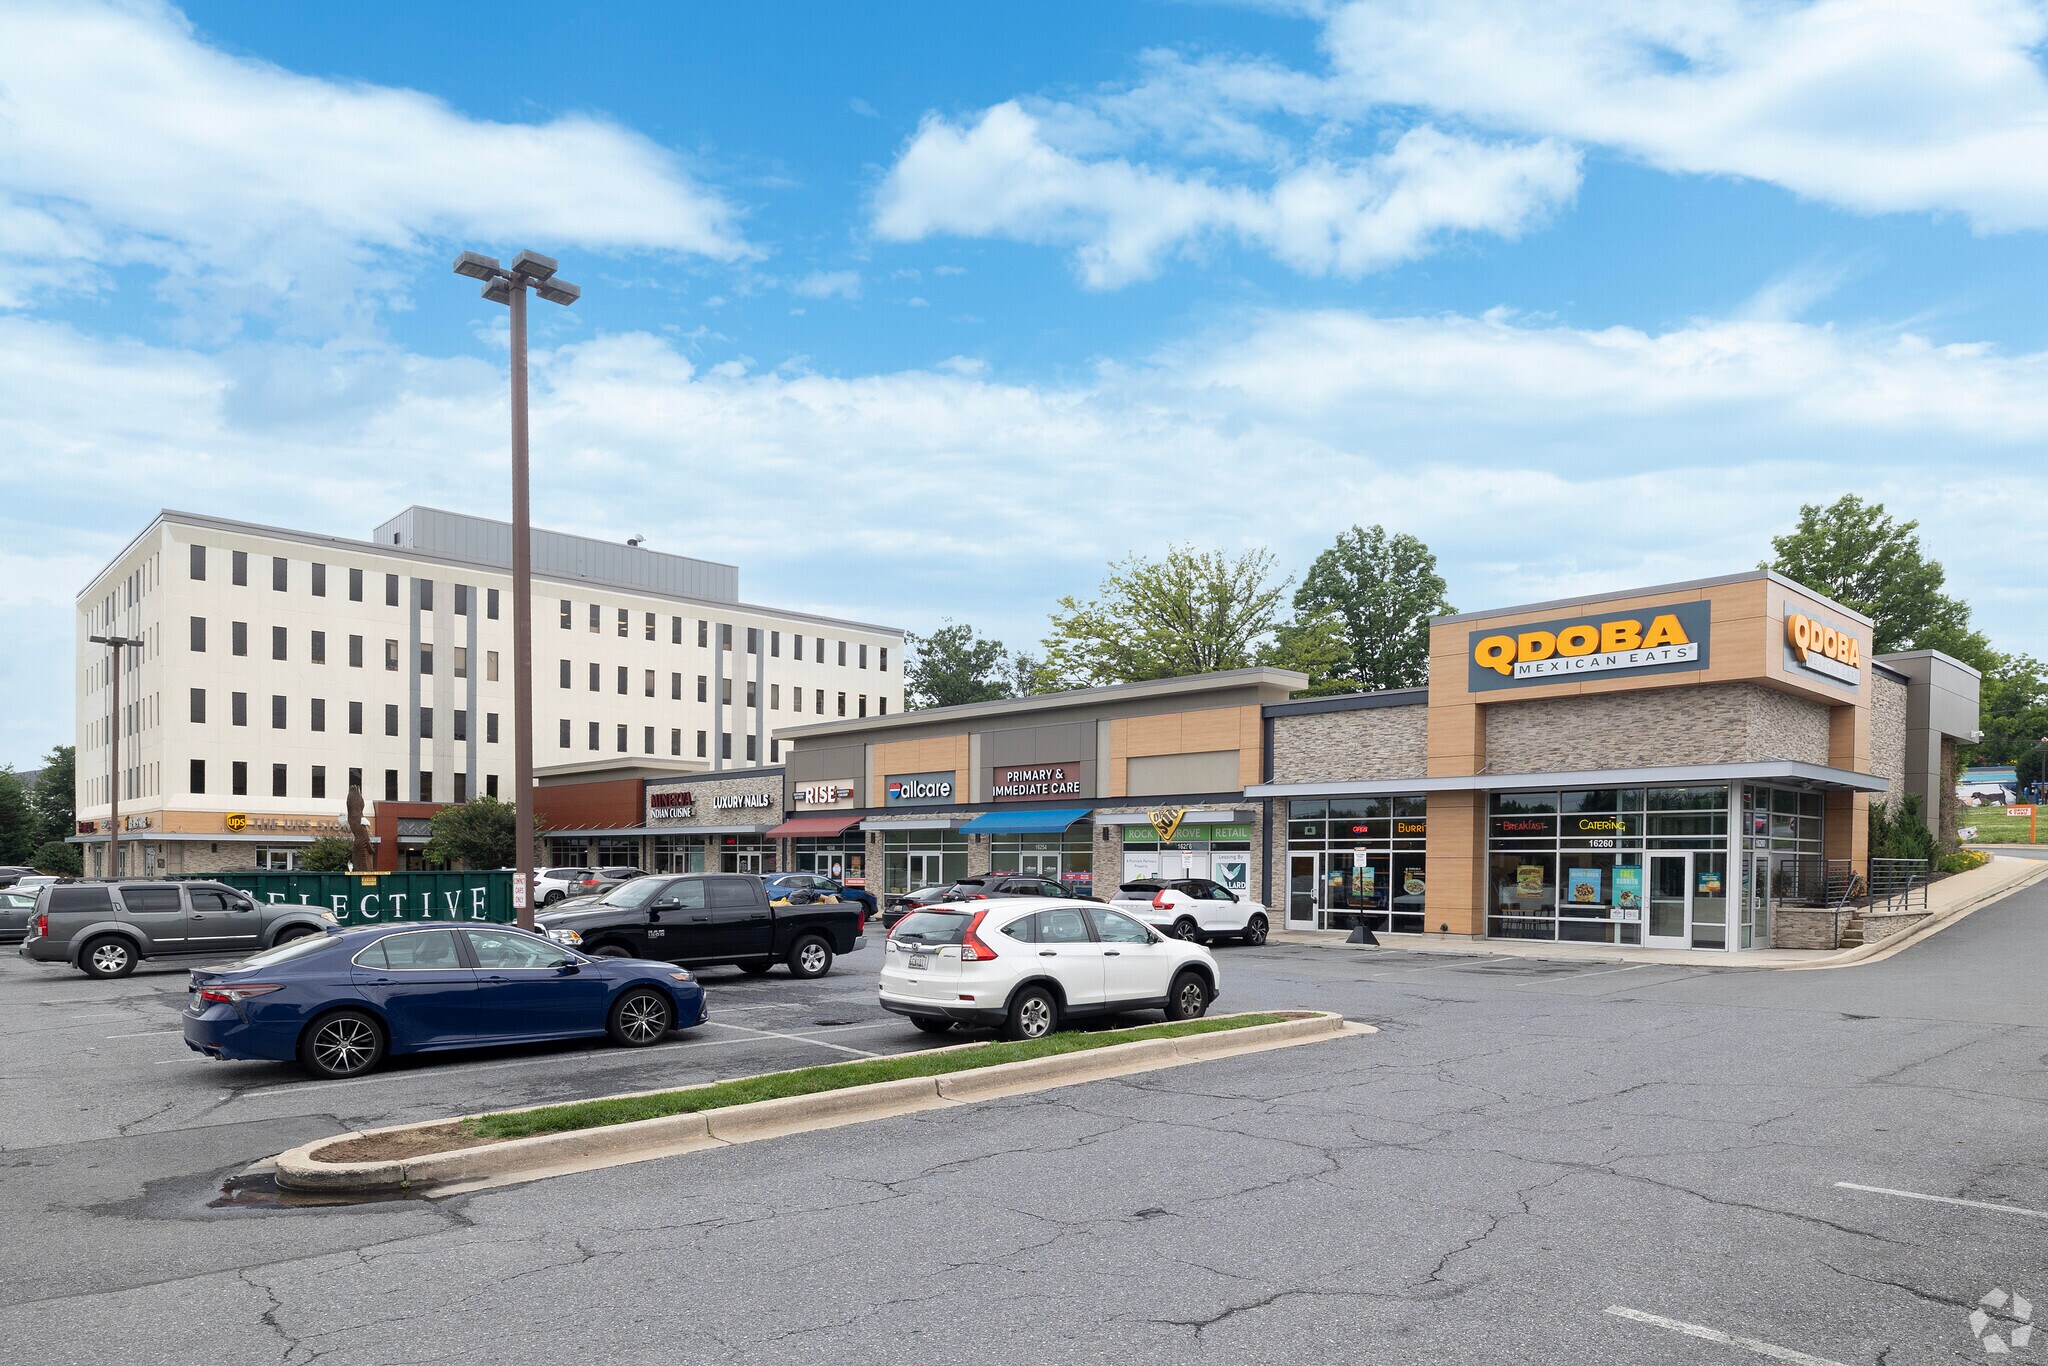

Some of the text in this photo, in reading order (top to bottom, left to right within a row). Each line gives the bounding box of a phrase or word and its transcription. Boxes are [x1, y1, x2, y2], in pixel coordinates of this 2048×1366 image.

[1474, 614, 1690, 676] QDOBA
[1788, 613, 1860, 669] QDOBA
[1519, 655, 1617, 674] MEXICAN
[1007, 768, 1064, 782] PRIMARY &
[805, 785, 836, 804] RISE
[901, 780, 950, 799] allcare
[992, 781, 1080, 796] IMMEDIATE CARE
[650, 791, 693, 807] MINERVA
[713, 794, 769, 809] LUXURY NAILS
[650, 807, 692, 818] INDIAN CUISINE
[228, 816, 245, 829] ups
[252, 817, 278, 830] THE
[284, 818, 312, 831] UPS
[1397, 822, 1426, 833] BURRI
[1579, 819, 1626, 832] CATERING
[1128, 828, 1247, 839] ROCK ROVE RETAIL
[1589, 839, 1614, 848] 16260
[1620, 870, 1635, 879] FREE
